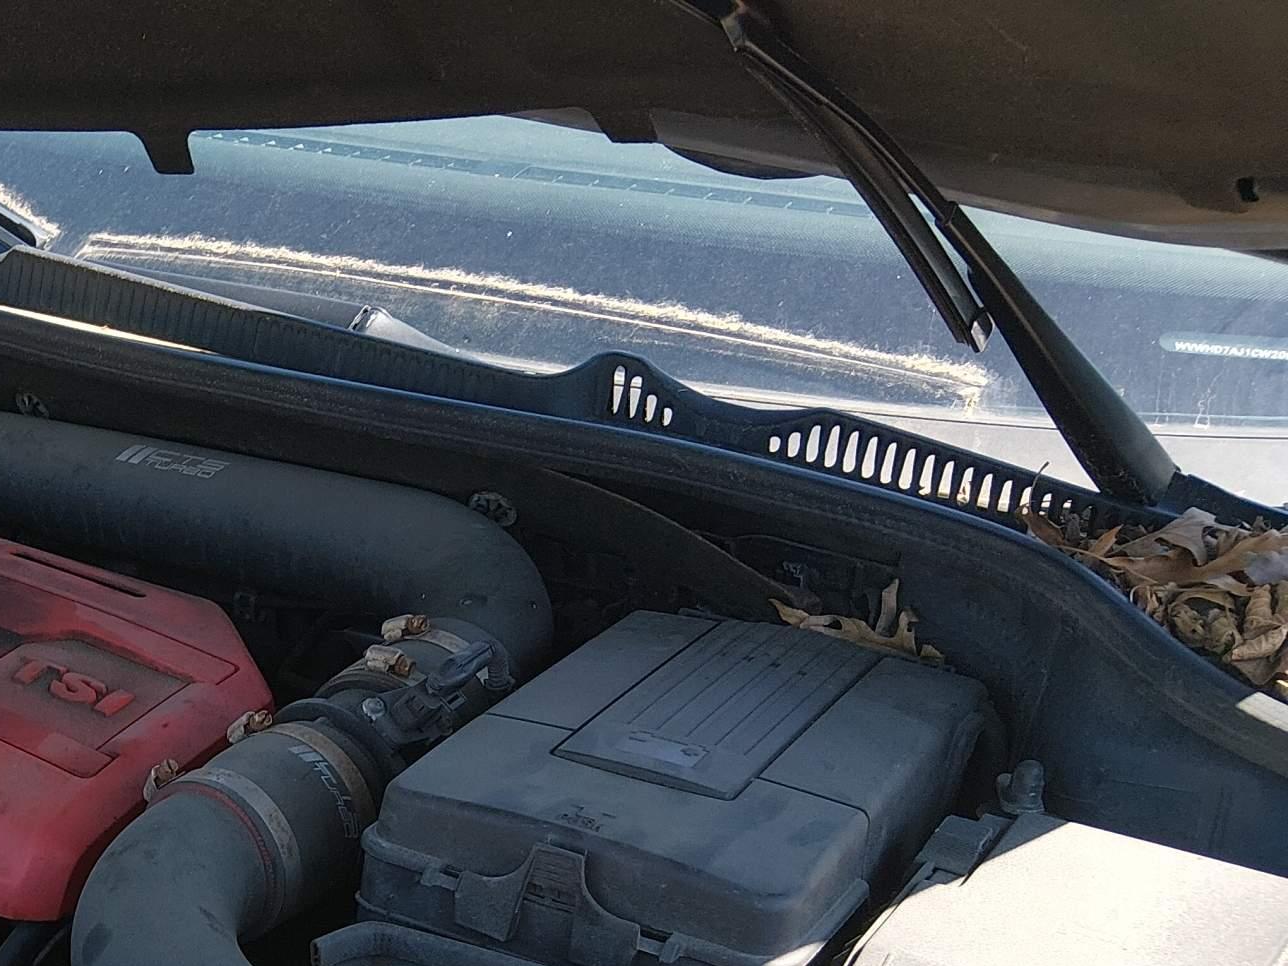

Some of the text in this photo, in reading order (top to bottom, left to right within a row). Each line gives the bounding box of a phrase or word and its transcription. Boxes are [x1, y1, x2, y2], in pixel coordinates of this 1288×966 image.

[145, 459, 216, 478] TURBO
[147, 449, 231, 471] CTS
[11, 657, 136, 718] TSI
